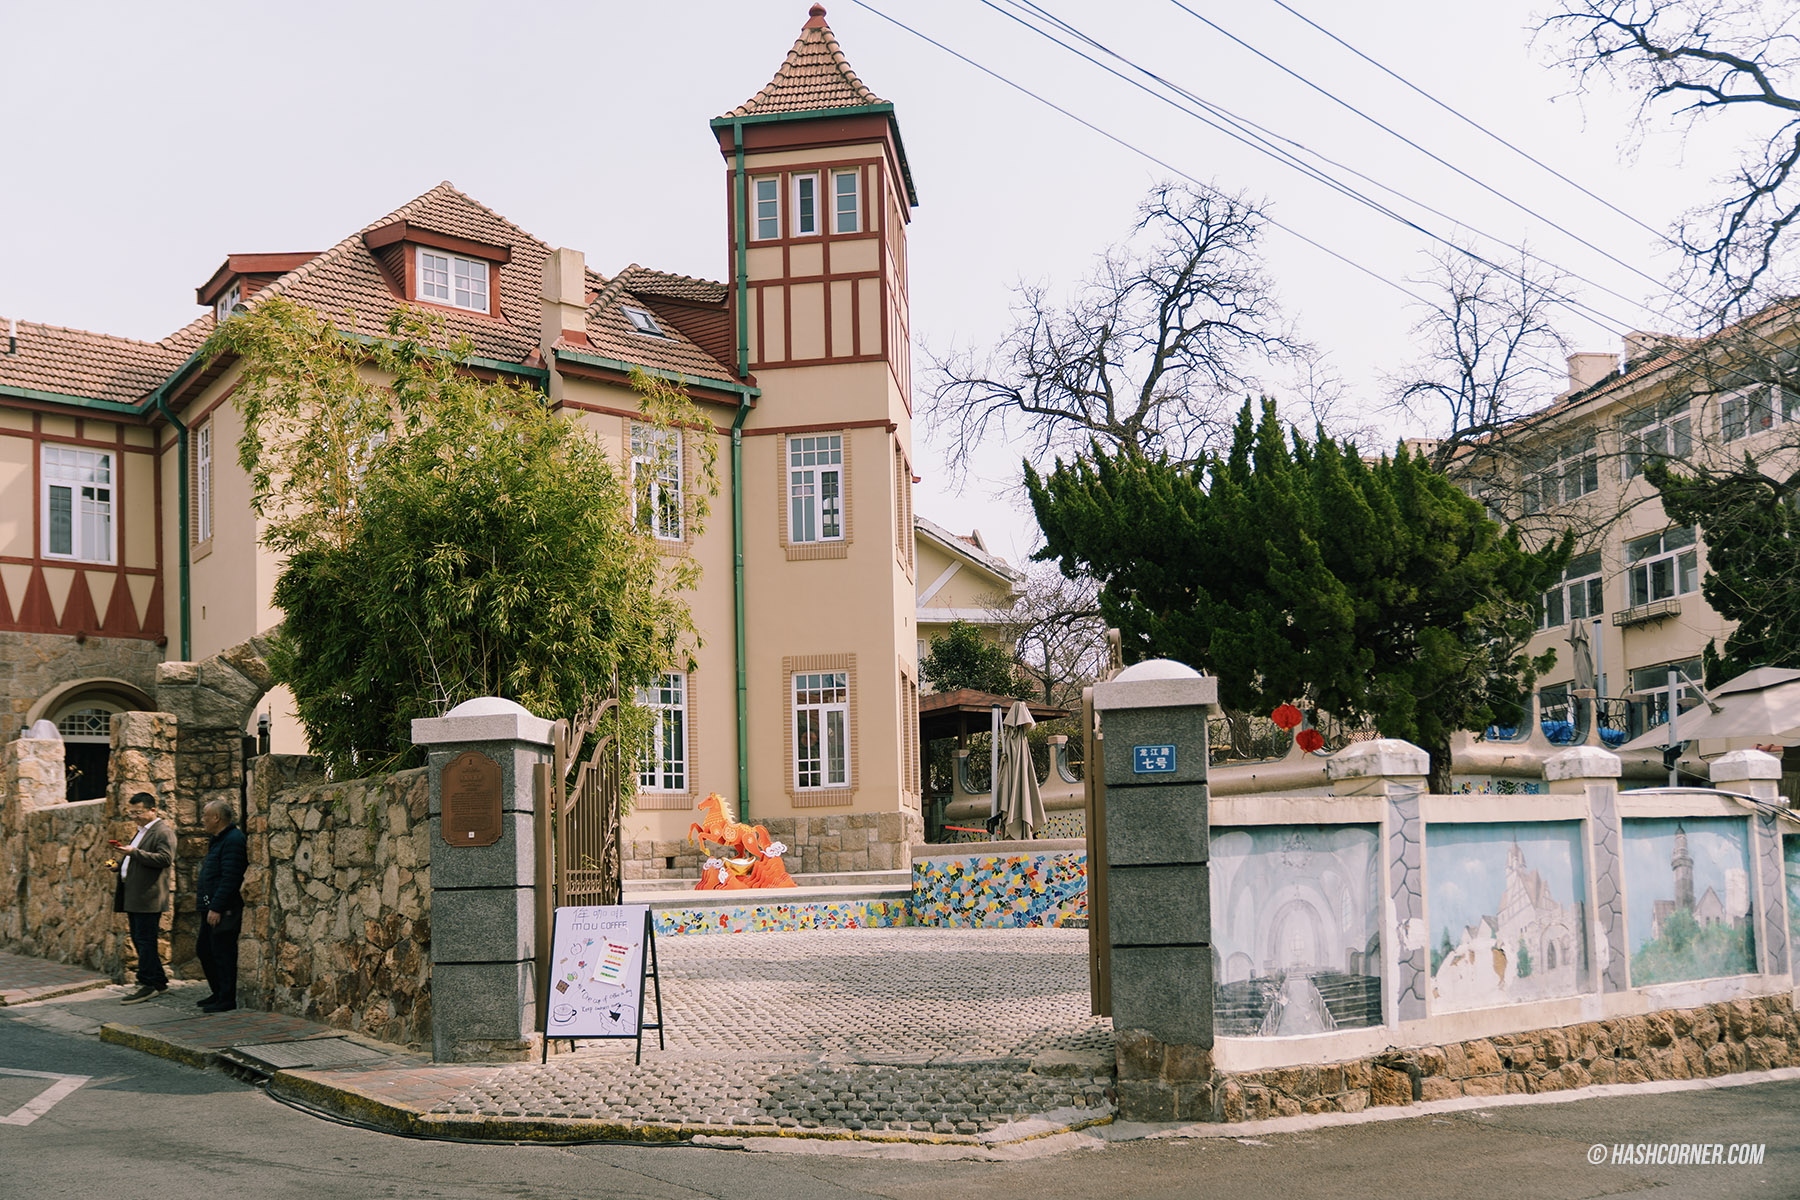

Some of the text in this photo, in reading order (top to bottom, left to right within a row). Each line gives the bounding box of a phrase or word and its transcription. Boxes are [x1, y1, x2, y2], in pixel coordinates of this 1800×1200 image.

[1140, 747, 1169, 756] 龙江路
[1142, 757, 1167, 769] 七号
